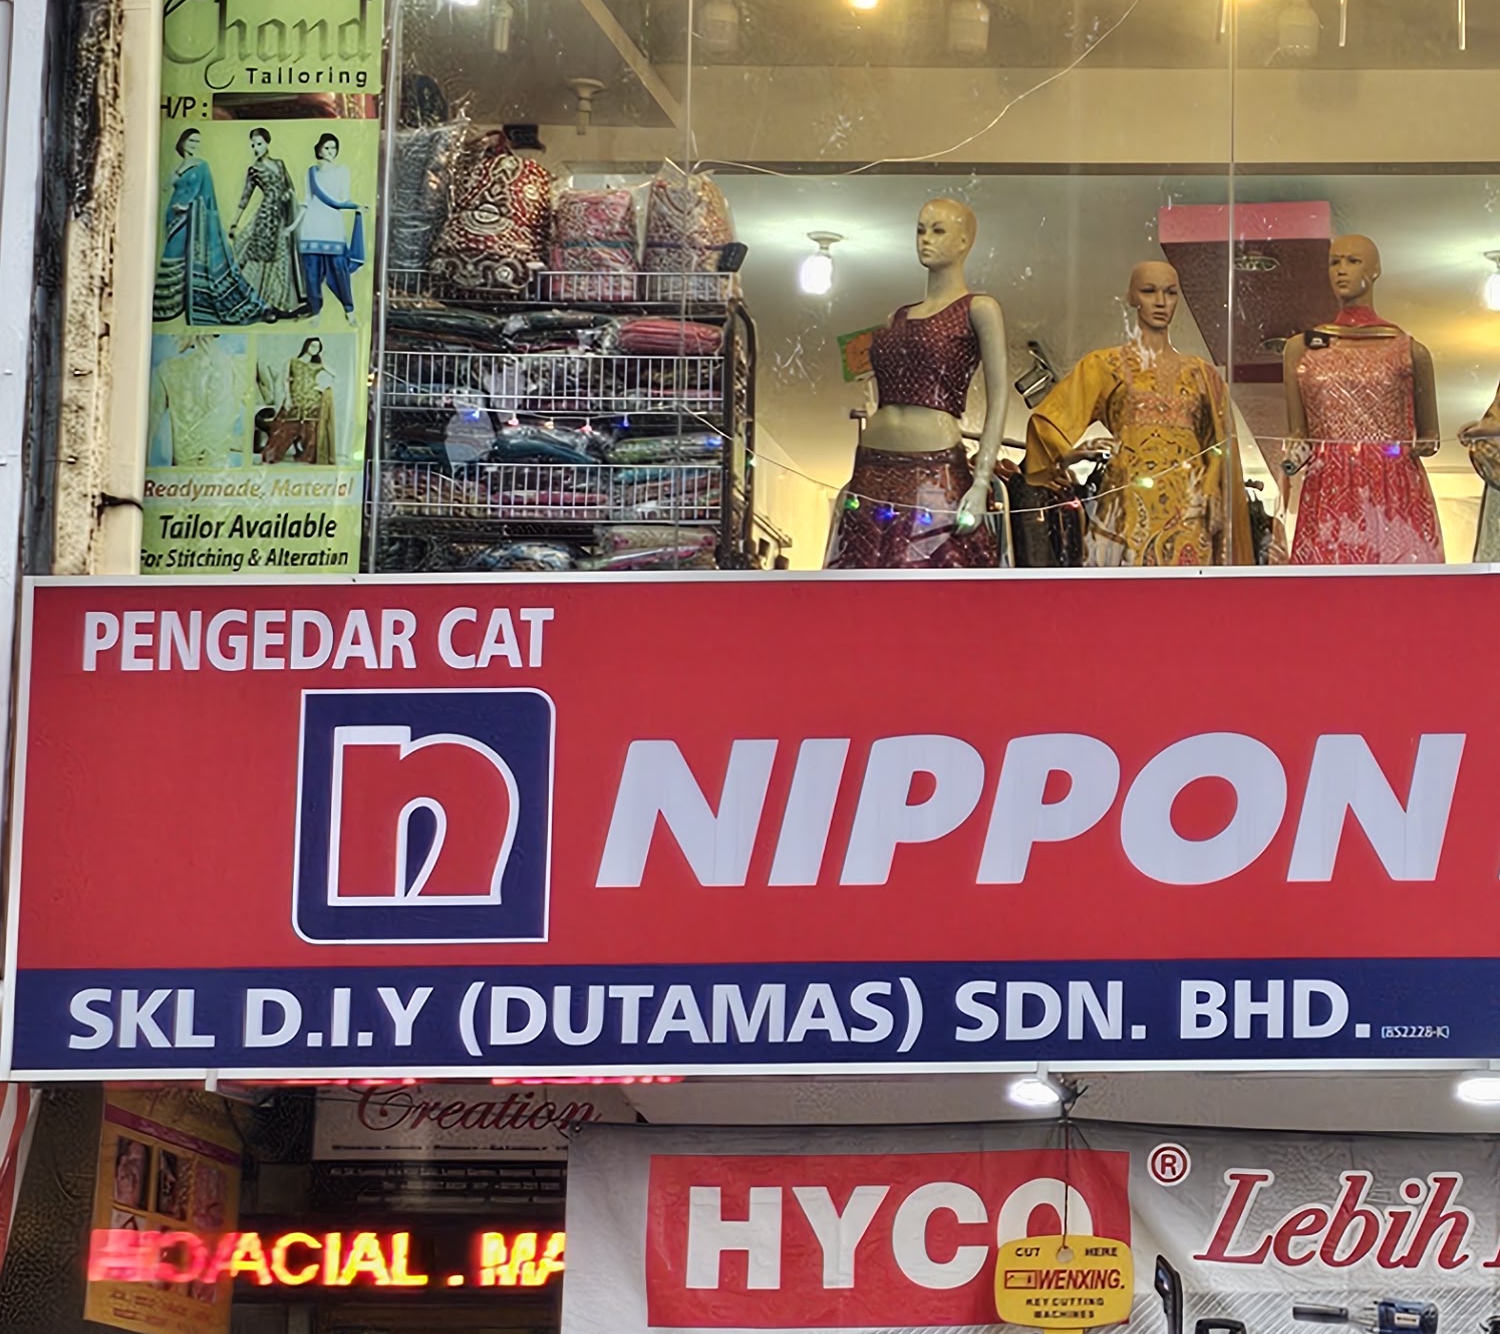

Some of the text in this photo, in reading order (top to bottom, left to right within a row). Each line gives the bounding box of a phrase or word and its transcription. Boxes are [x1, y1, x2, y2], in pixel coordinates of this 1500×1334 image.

[246, 66, 368, 88] Tailoring
[269, 478, 354, 498] Material
[160, 514, 337, 540] Tailor Available
[140, 546, 348, 572] For Stitching & Alteration
[83, 607, 554, 672] PENGEDAR CAT
[596, 731, 1466, 888] NIPPON
[69, 988, 215, 1050] SKL
[244, 986, 434, 1049] D.I.Y
[459, 977, 923, 1056] (DUTAMAS)
[955, 979, 1147, 1044] SDN.
[1180, 979, 1371, 1040] BHD.
[358, 1084, 602, 1131] Creation
[1194, 1170, 1470, 1268] Lebih
[1015, 1247, 1118, 1257] CUT HERE
[1052, 1297, 1104, 1306] CUTTING
